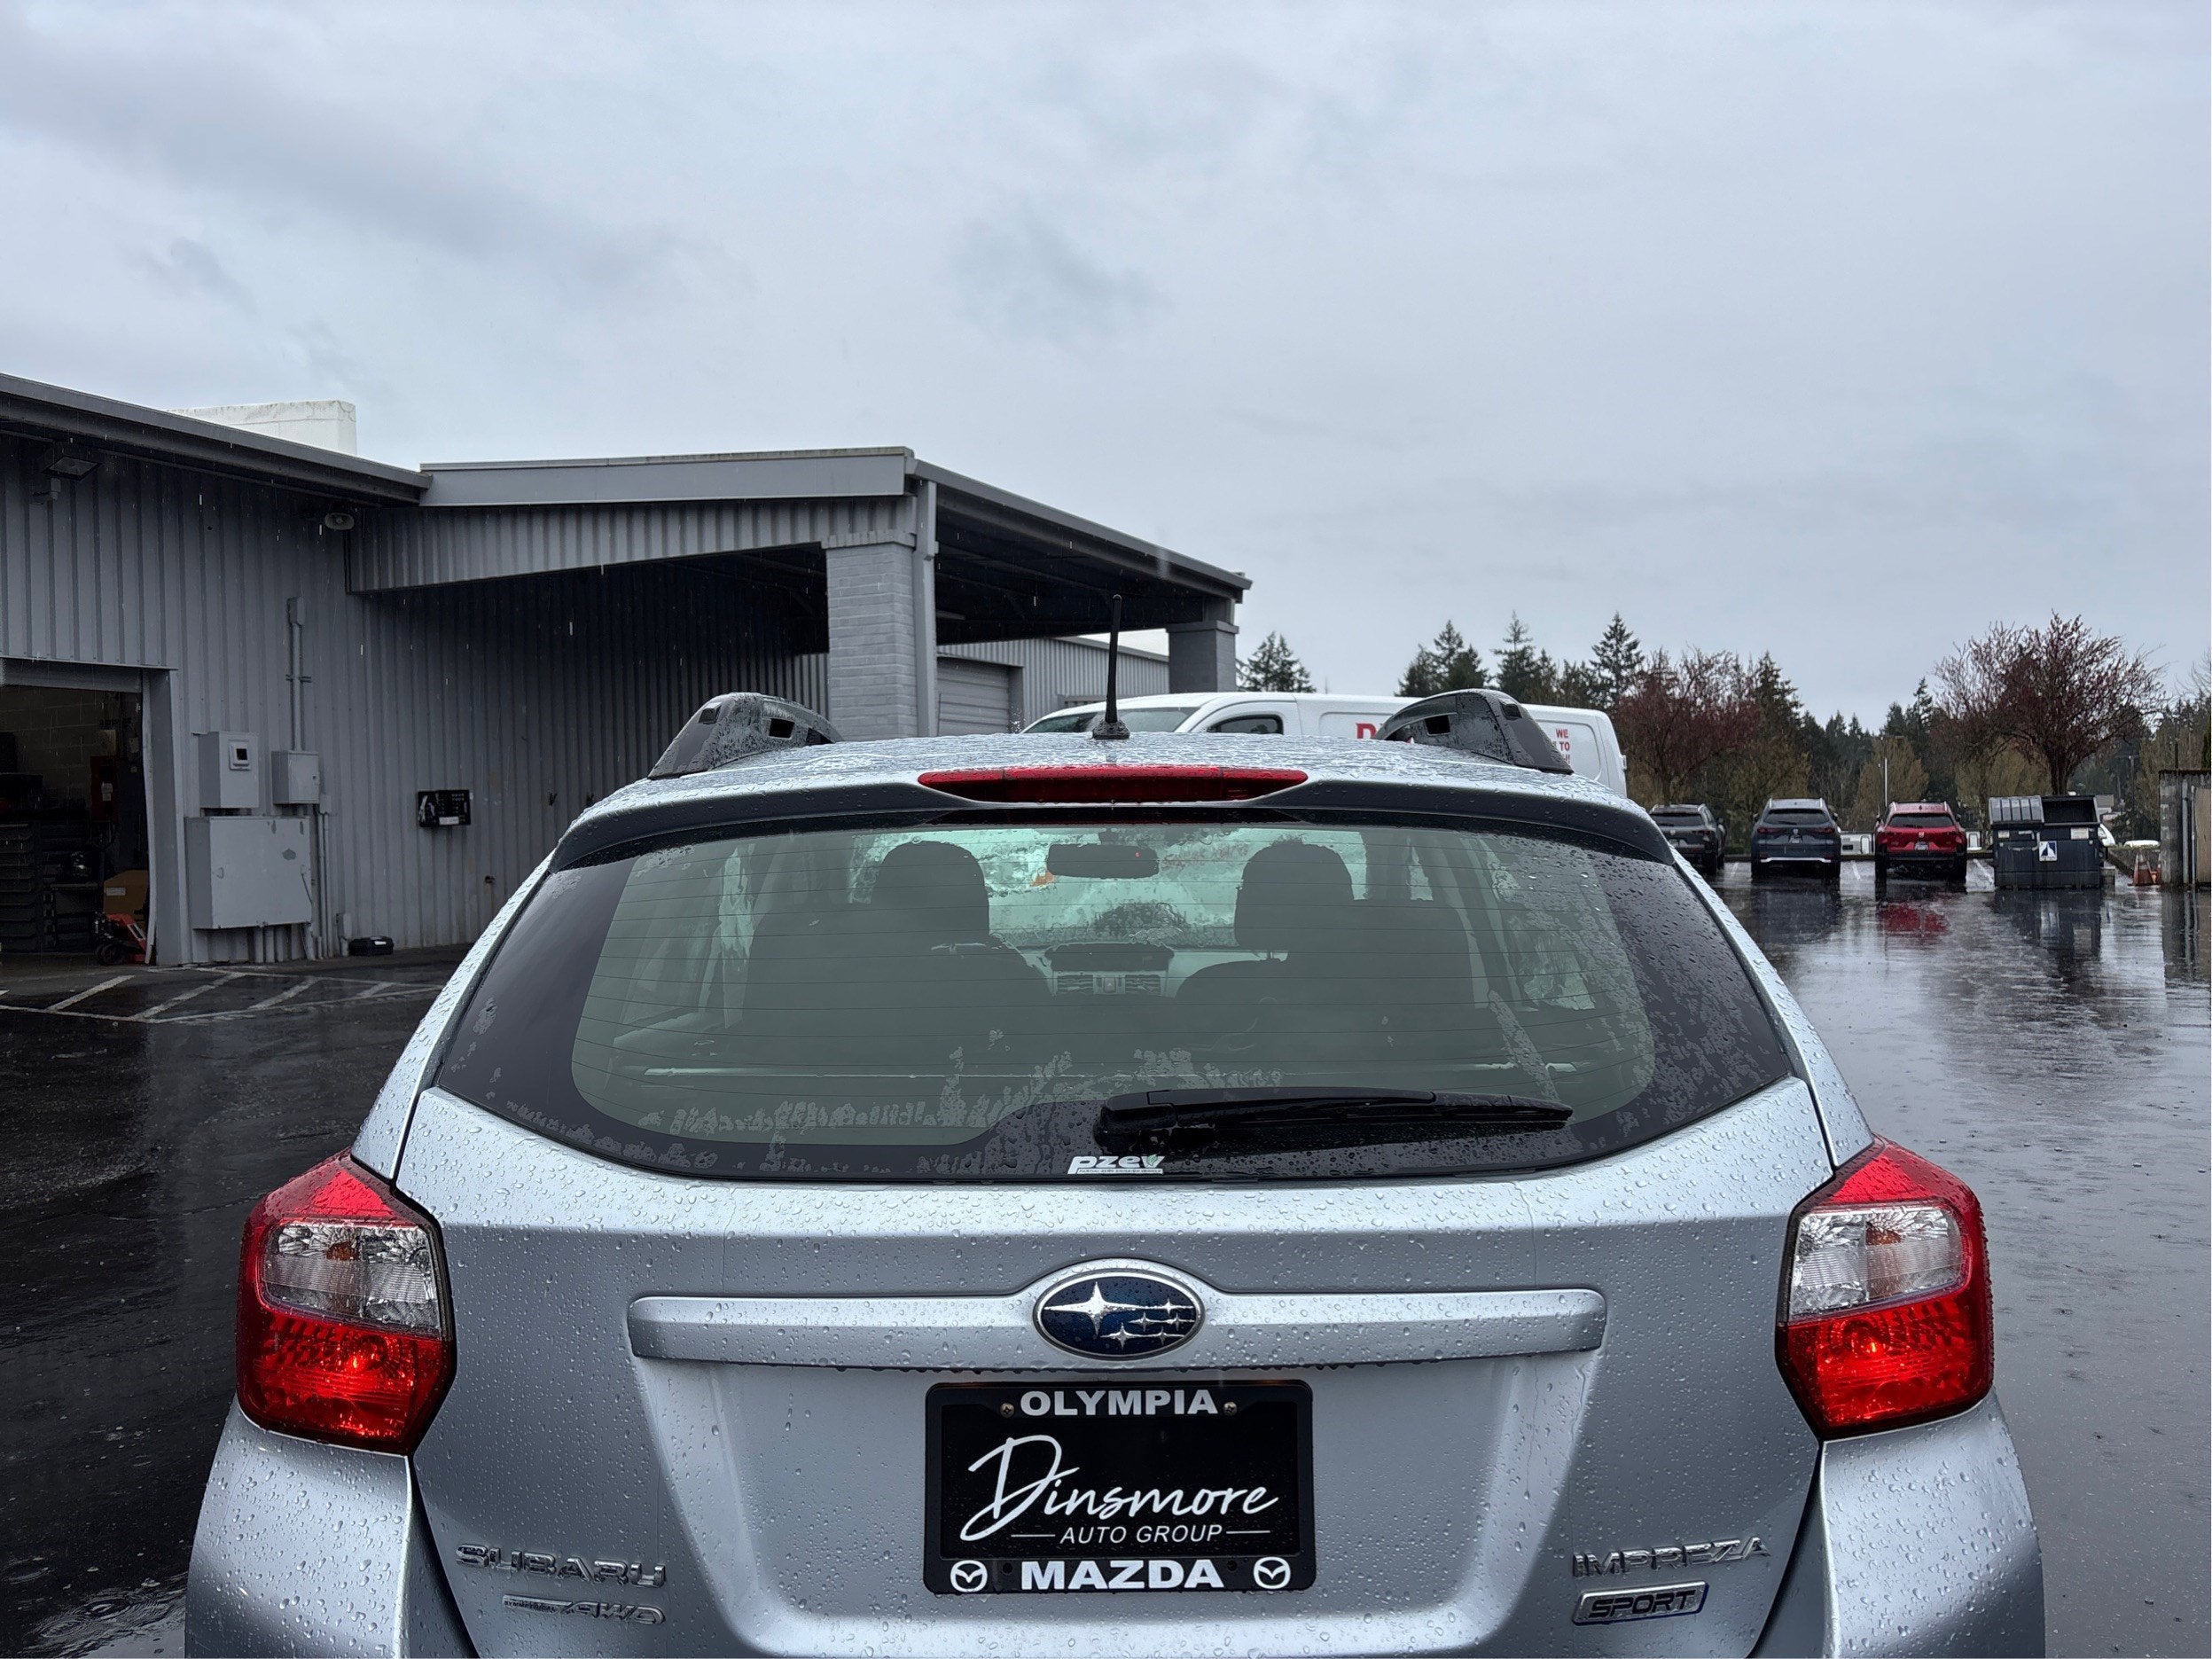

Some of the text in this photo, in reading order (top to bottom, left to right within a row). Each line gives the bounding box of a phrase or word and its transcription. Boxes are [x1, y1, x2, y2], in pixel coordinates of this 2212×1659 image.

[1556, 728, 1568, 739] WE
[1559, 741, 1570, 751] TO
[1020, 1390, 1218, 1416] OLYMPIA
[959, 1435, 1278, 1542] Dinsmore
[1060, 1524, 1223, 1544] AUTO GROUP
[456, 1543, 667, 1587] SUBARU
[1573, 1537, 1771, 1577] IMPREZA
[1021, 1560, 1224, 1591] MAZDA
[560, 1600, 666, 1624] AWD
[1589, 1590, 1696, 1618] SPORT
